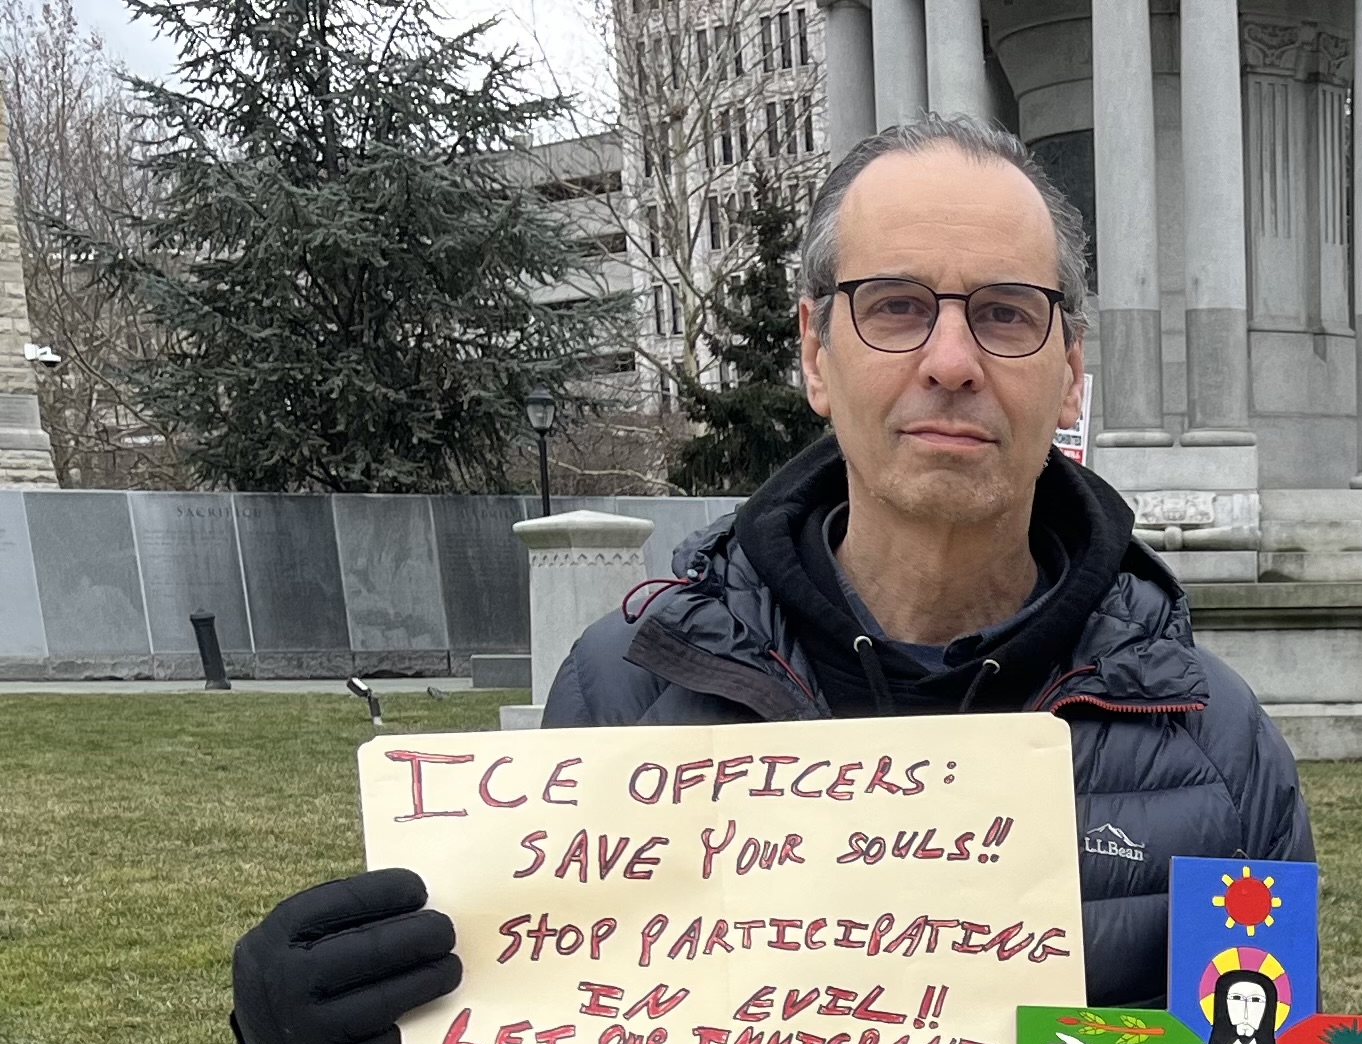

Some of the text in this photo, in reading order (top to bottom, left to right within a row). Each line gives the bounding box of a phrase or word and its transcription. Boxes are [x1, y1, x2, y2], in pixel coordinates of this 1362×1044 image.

[385, 750, 956, 822] ICE OFFICERS:
[513, 829, 669, 883] SAVE
[837, 816, 1014, 865] SOULS!!
[639, 913, 1070, 967] PARTICIPATING
[578, 982, 949, 1029] IN EVIL!!
